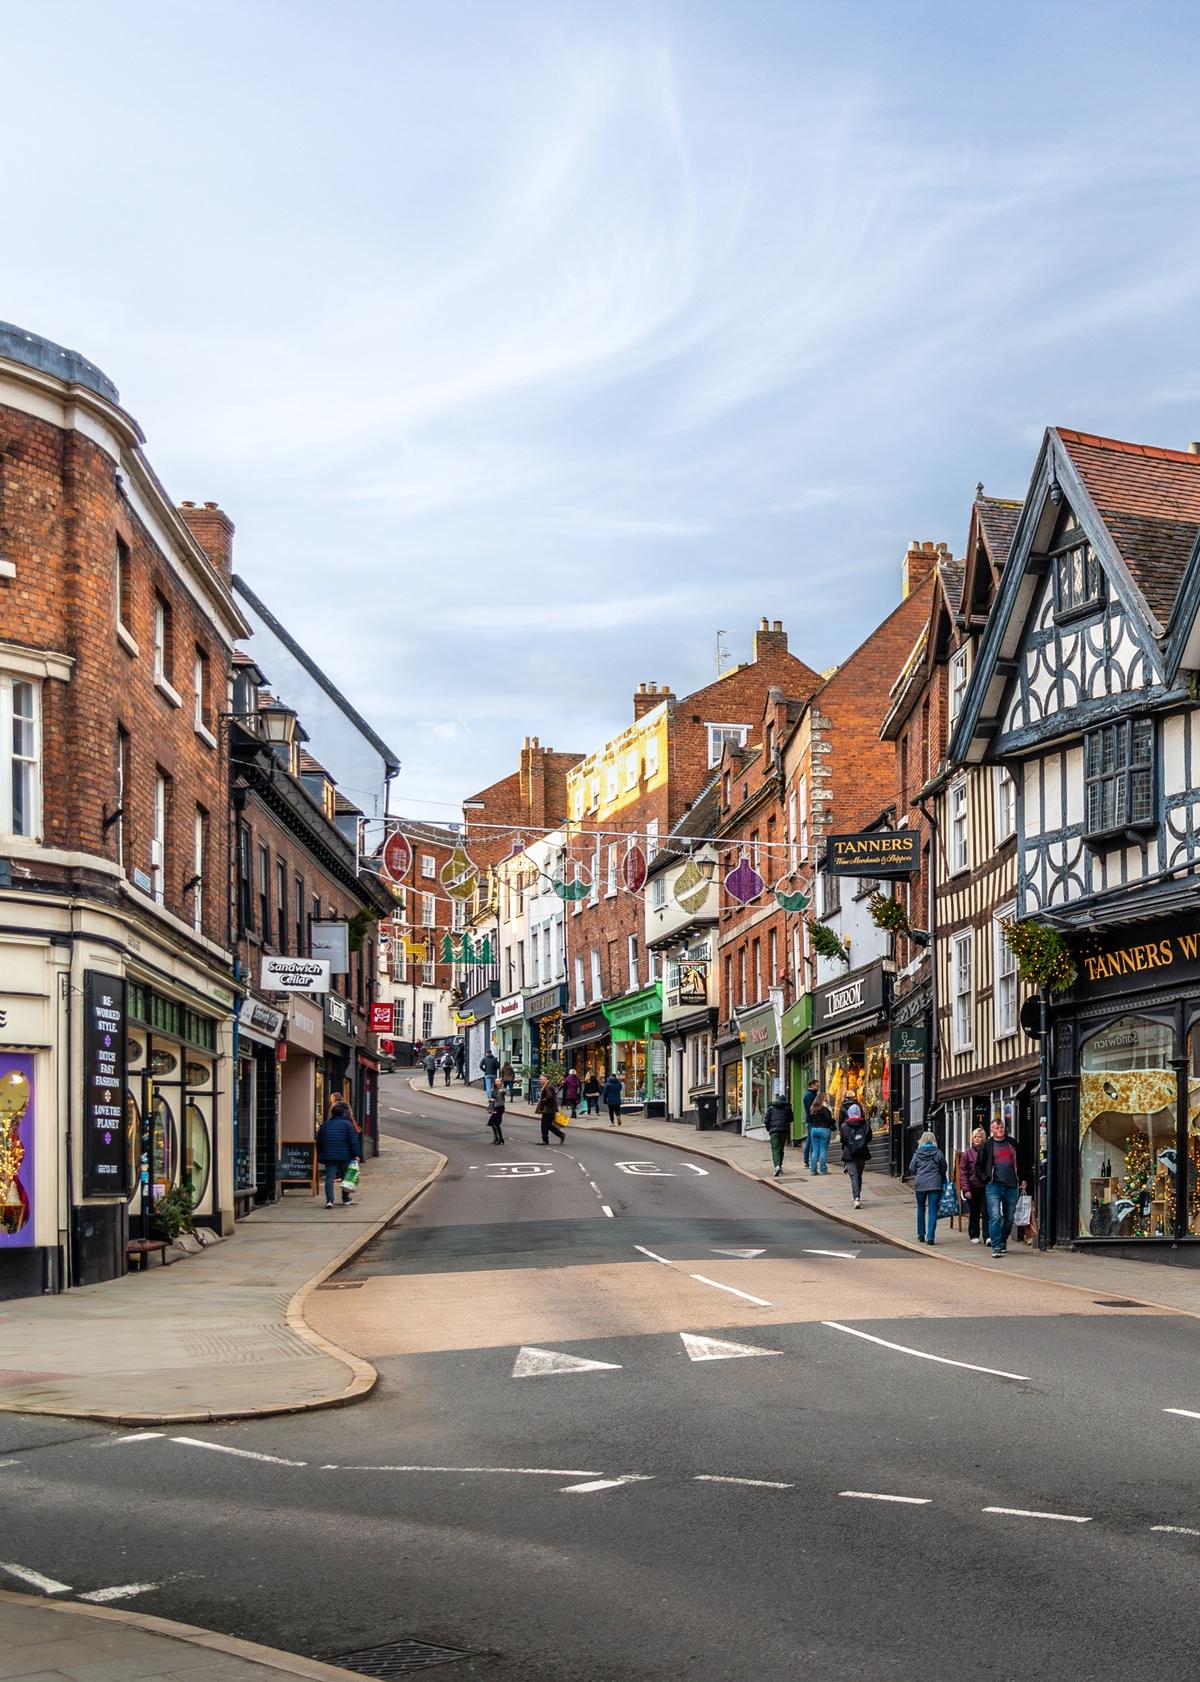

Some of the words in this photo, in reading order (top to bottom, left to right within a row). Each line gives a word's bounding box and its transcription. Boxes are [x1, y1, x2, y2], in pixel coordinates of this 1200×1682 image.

[834, 838, 913, 854] TANNERS
[835, 856, 849, 865] Wine
[849, 856, 880, 865] Merchants
[885, 854, 912, 864] Shippers
[1084, 939, 1174, 980] TANNERS
[268, 961, 322, 975] Sandwich
[280, 975, 313, 986] Cellar
[96, 1007, 121, 1020] WORKED
[99, 1050, 116, 1062] DITCH
[100, 1063, 115, 1074] FAST
[96, 1076, 120, 1087] FASHION
[95, 1105, 109, 1115] LOVE
[97, 1118, 119, 1128] PLANET
